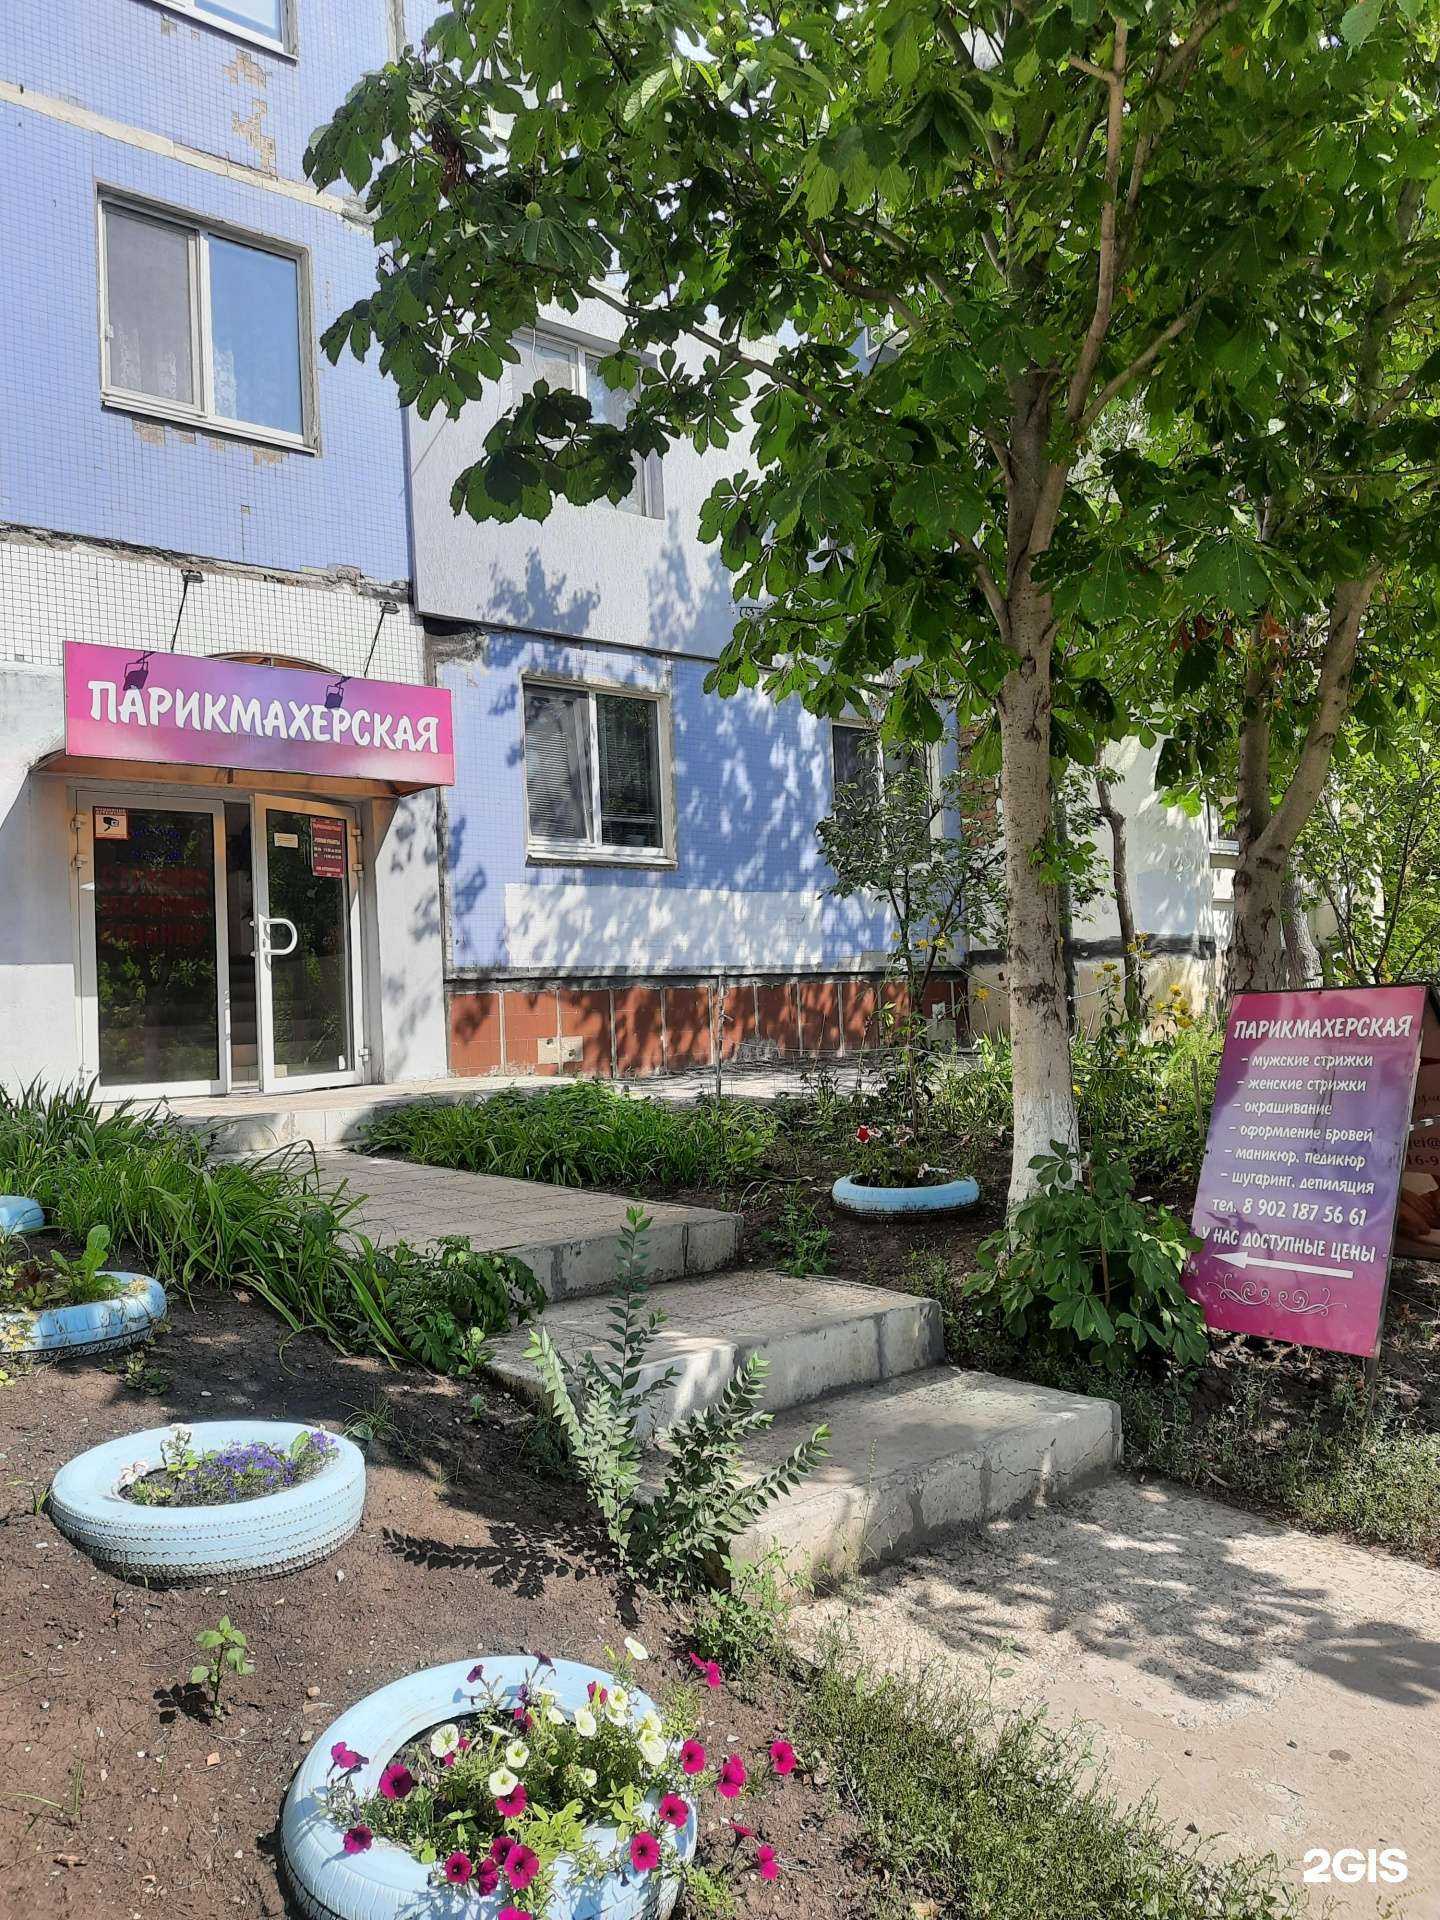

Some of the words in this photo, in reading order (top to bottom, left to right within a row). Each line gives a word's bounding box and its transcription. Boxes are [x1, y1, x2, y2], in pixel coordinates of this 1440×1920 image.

[88, 681, 439, 753] ПАРИКМАХЕРСКАЯ
[1233, 1015, 1413, 1039] ПАРИКМАХЕРСКАЯ
[1252, 1055, 1309, 1069] мужские
[1314, 1055, 1373, 1070] стрижки
[1248, 1077, 1303, 1091] женские
[1307, 1079, 1367, 1094] стрижки
[1244, 1100, 1333, 1115] окрашивание
[1240, 1125, 1321, 1140] оформление
[1305, 1152, 1366, 1171] педикюр
[1299, 1177, 1375, 1195] депиляция
[1212, 1198, 1237, 1213] тел.
[1242, 1198, 1253, 1214] 8
[1257, 1199, 1286, 1218] 902
[1292, 1202, 1318, 1221] 187
[1322, 1206, 1344, 1224] 56
[1349, 1207, 1367, 1226] 61
[1213, 1229, 1240, 1245] НАС
[1242, 1232, 1326, 1257] ДОСТУПНЫЕ
[1330, 1242, 1376, 1263] ЦЕНЫ
